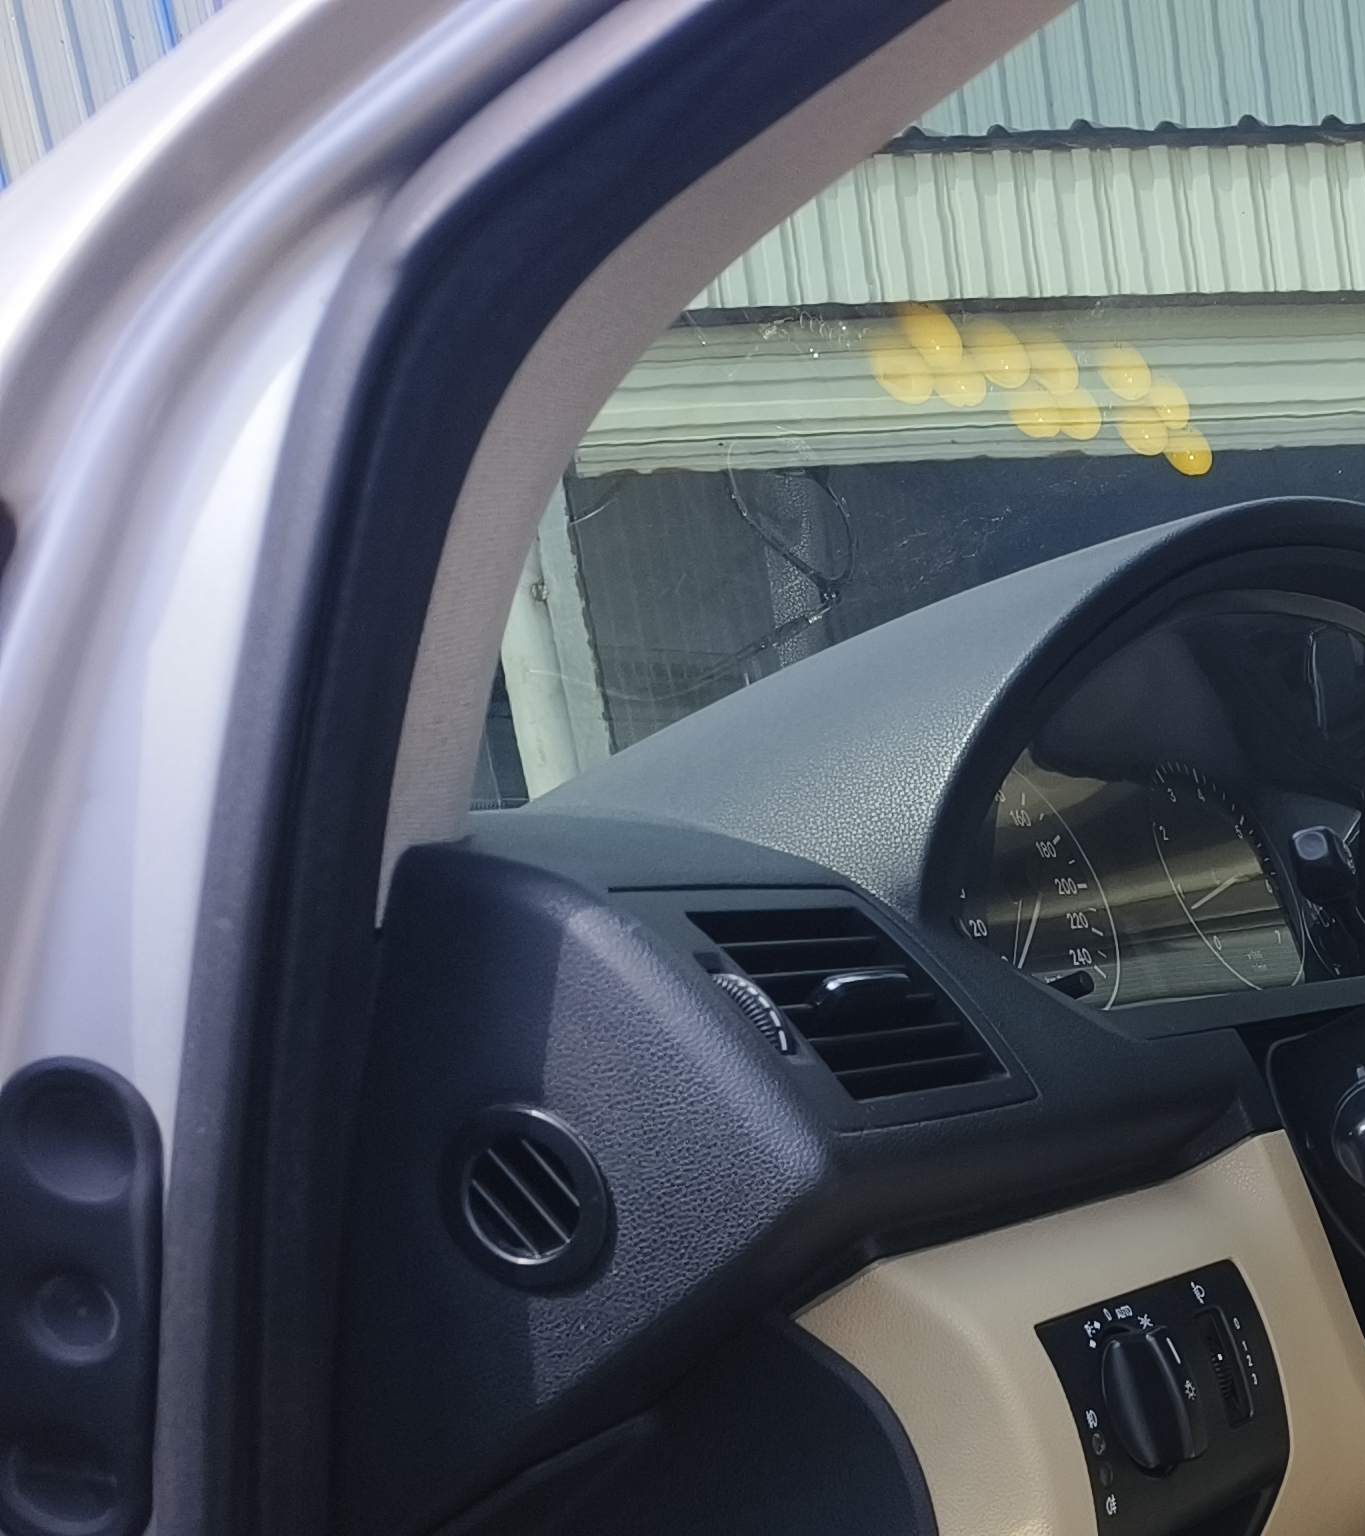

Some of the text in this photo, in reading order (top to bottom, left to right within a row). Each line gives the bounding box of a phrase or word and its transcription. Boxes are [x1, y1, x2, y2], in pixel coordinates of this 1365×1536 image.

[1167, 787, 1177, 803] 3
[1009, 809, 1032, 827] 160
[1159, 825, 1169, 841] 2
[1234, 824, 1244, 839] 5
[1035, 841, 1057, 858] 180
[1054, 877, 1078, 895] 200
[969, 918, 988, 937] 20
[1066, 911, 1089, 929] 220
[1274, 929, 1281, 944] 7
[1068, 947, 1092, 966] 240
[1246, 1354, 1253, 1367] 2
